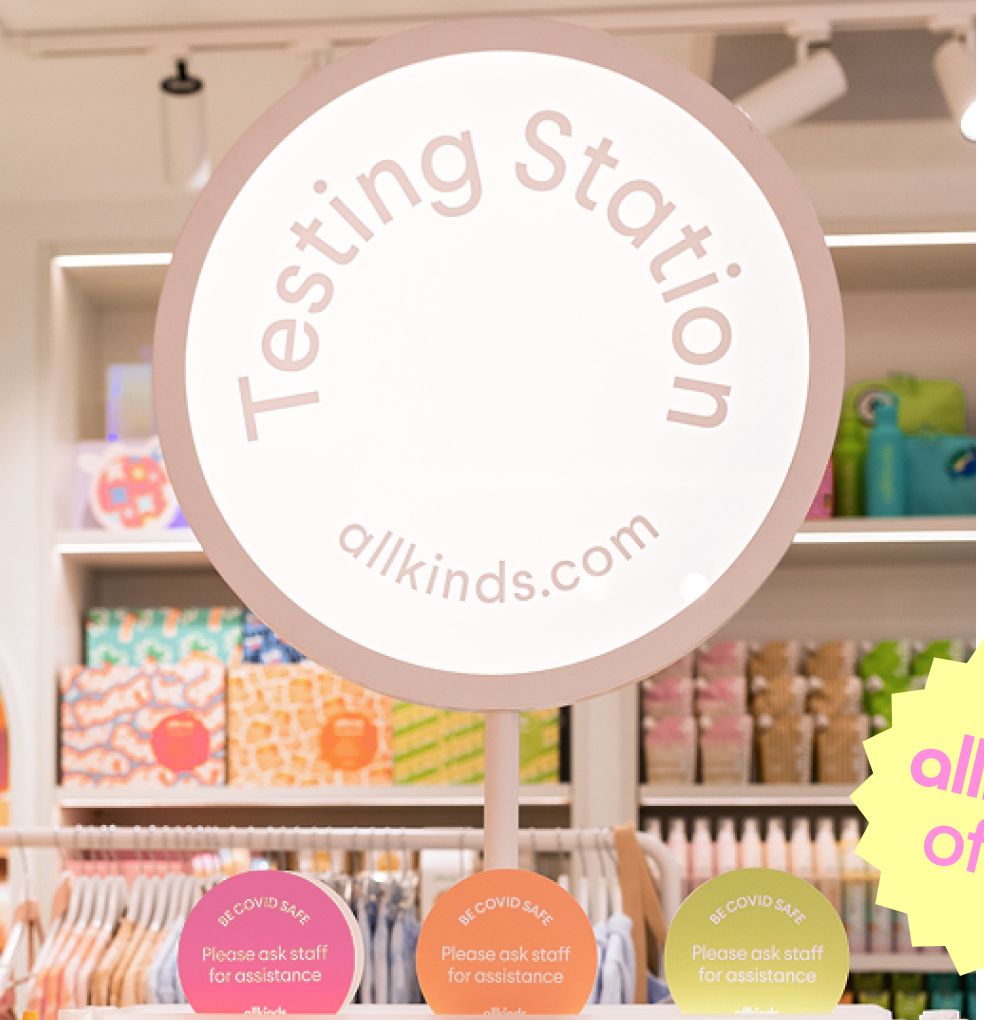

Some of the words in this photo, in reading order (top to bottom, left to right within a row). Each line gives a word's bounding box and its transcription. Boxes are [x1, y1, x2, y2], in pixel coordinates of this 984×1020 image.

[237, 128, 485, 442] Testing
[513, 109, 742, 430] Station
[338, 510, 661, 604] allkinds.com
[217, 909, 235, 927] BE
[233, 897, 278, 915] COVID
[280, 900, 312, 927] SAFE
[457, 908, 476, 927] BE
[474, 896, 521, 914] COVID
[522, 900, 554, 927] SAFE
[709, 907, 728, 926] BE
[725, 895, 773, 914] COVID
[774, 898, 807, 926] SAFE
[202, 946, 256, 962] Please
[258, 945, 287, 961] ask
[290, 944, 328, 961] staff
[441, 945, 496, 962] Please
[499, 945, 528, 961] ask
[531, 945, 571, 962] staff
[691, 944, 747, 961] Please
[750, 944, 781, 961] ask
[784, 944, 824, 961] staff
[209, 967, 231, 984] for
[234, 967, 322, 983] assistance
[448, 967, 471, 984] for
[474, 967, 565, 984] assistance
[698, 966, 721, 983] for
[726, 967, 817, 983] assistance
